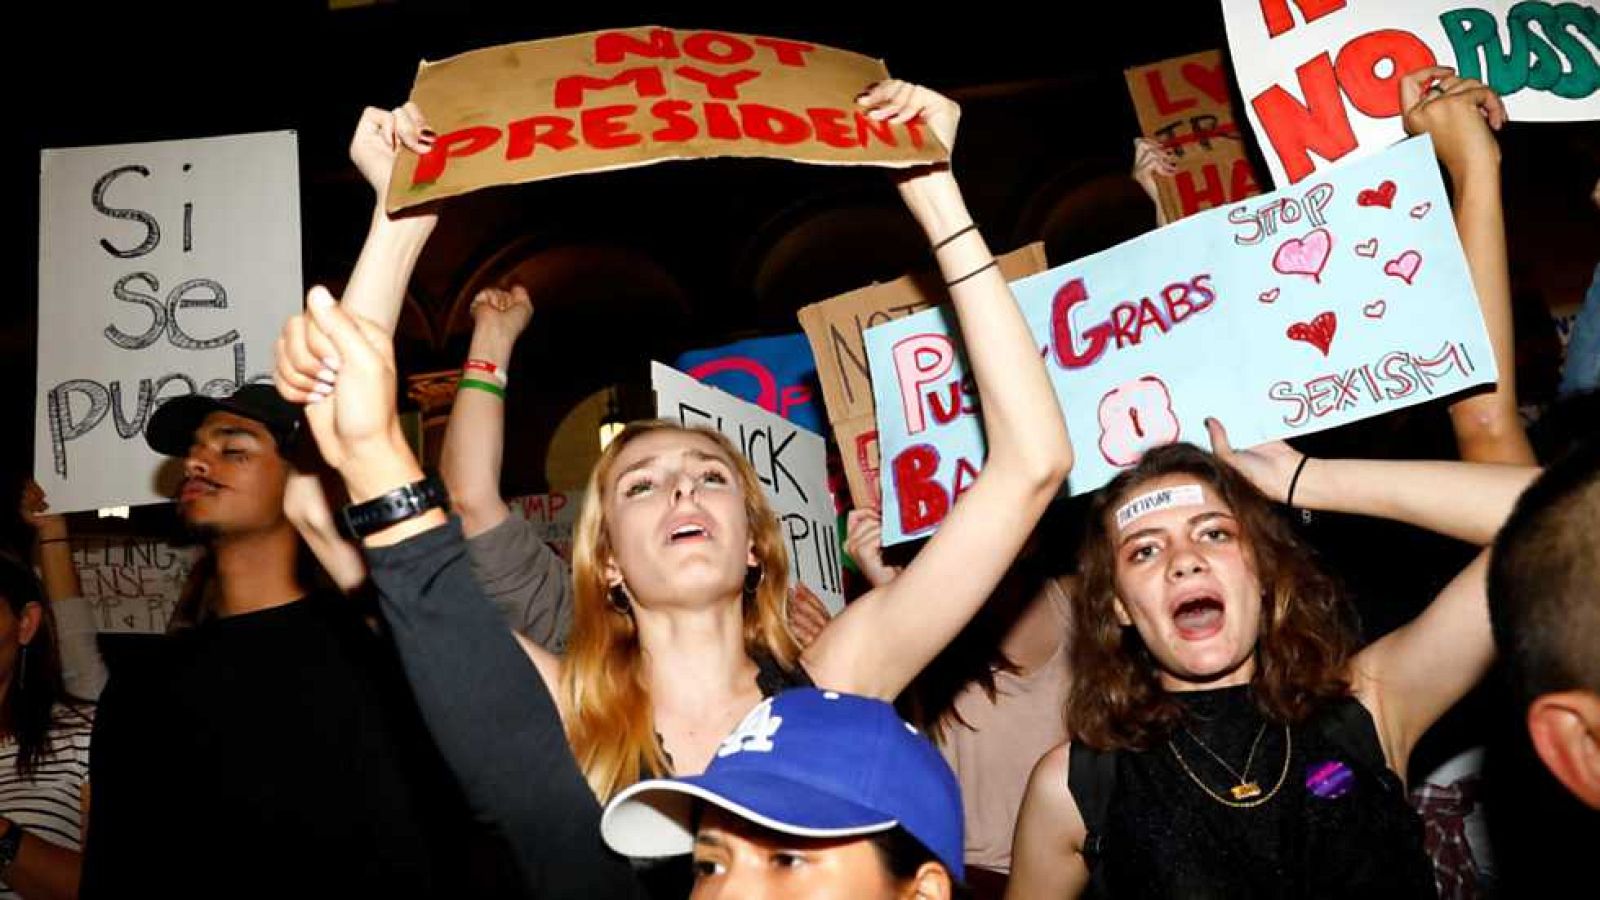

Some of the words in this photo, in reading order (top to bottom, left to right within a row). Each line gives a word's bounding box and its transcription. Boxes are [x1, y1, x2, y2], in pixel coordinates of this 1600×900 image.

[554, 66, 760, 109] MY
[594, 27, 815, 67] NOT
[1251, 29, 1437, 185] NO
[1439, 1, 1600, 99] PUSS
[411, 100, 927, 185] PRESIDENT
[91, 162, 193, 259] Si
[1175, 158, 1264, 218] HA
[1228, 183, 1335, 246] STOP
[1051, 274, 1217, 370] GRABS
[1268, 342, 1474, 428] SEXISM
[891, 443, 979, 536] BA
